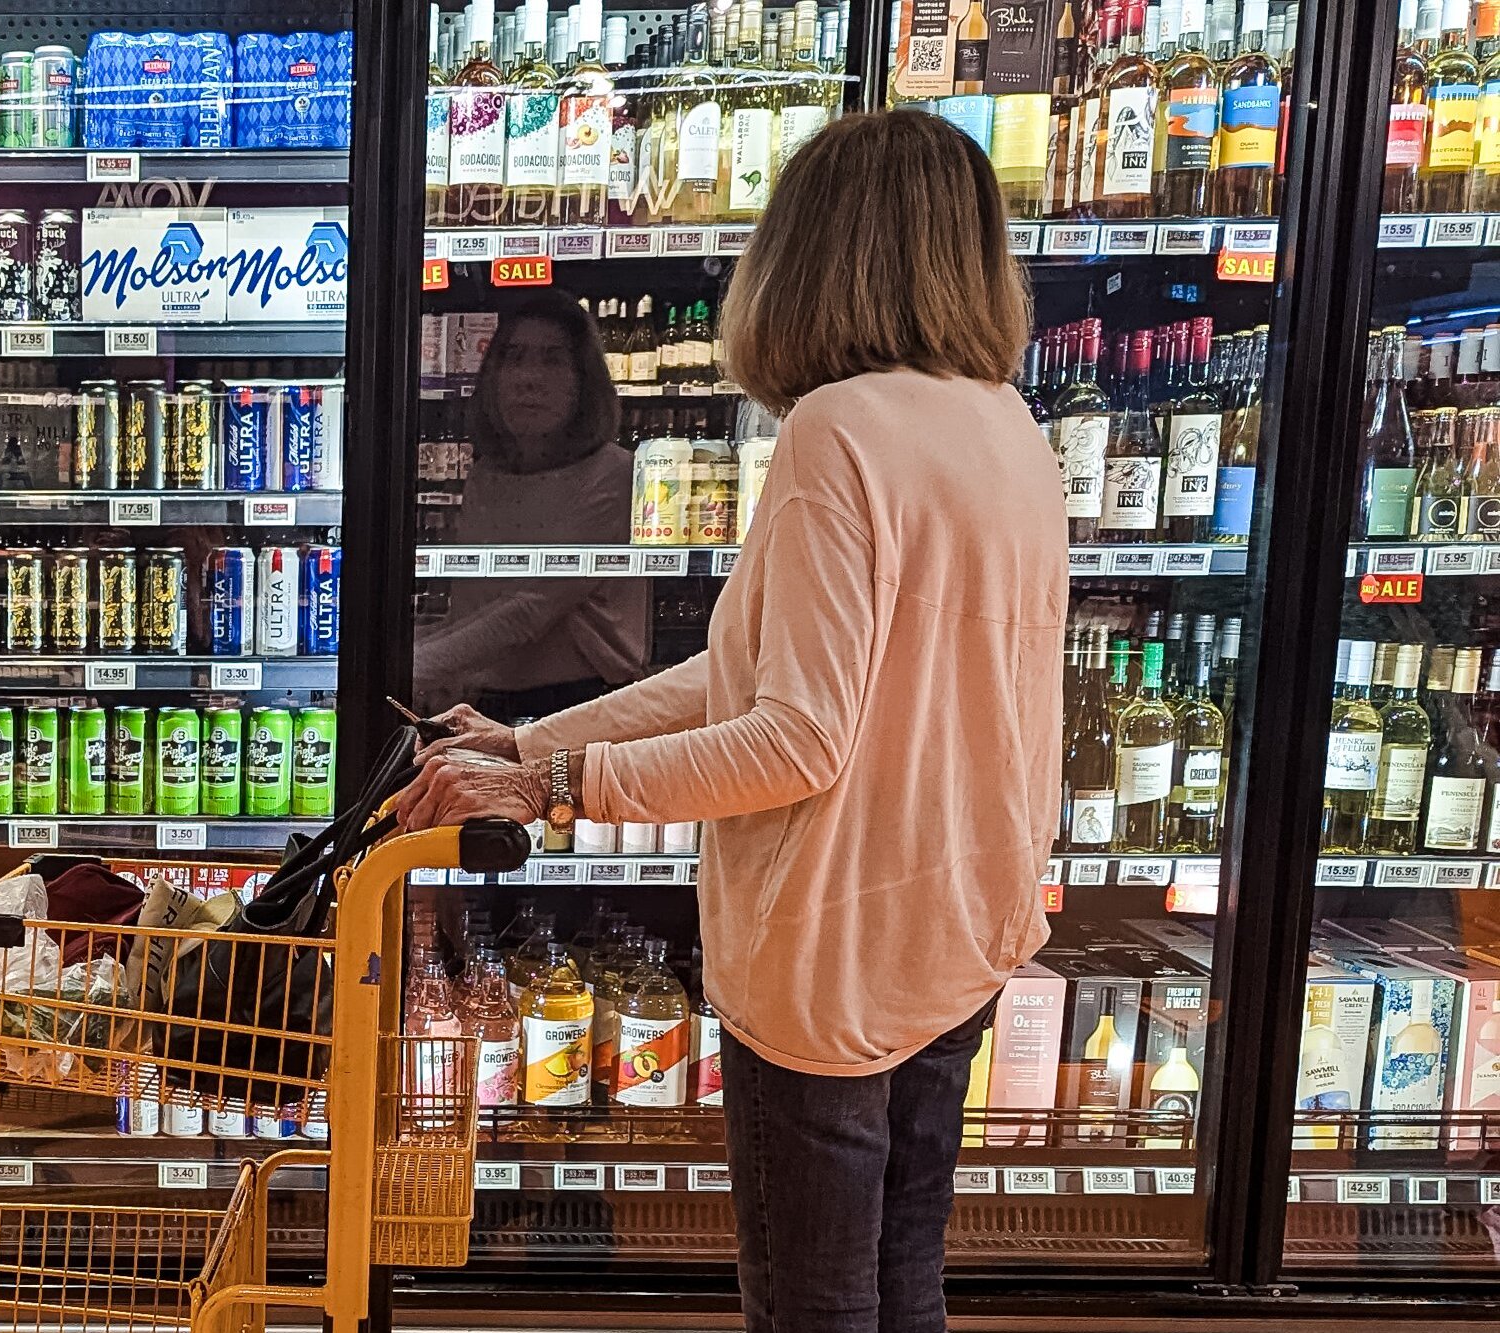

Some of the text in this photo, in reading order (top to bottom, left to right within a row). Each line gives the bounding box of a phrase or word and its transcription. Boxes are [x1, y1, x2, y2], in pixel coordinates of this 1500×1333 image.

[1233, 100, 1271, 109] SANDBANKS
[460, 154, 501, 166] BODACIOUS
[513, 155, 555, 168] BODACIOUS
[559, 153, 601, 167] BODACIOUS
[1125, 158, 1147, 167] INK
[41, 228, 66, 239] Buck
[1384, 224, 1412, 234] 15.95
[1443, 223, 1472, 233] 15.95
[619, 235, 647, 245] 12.95
[671, 233, 700, 243] 11.95
[1235, 230, 1255, 240] 12.95
[457, 238, 485, 249] 12.95
[561, 237, 590, 247] 12.95
[499, 263, 546, 280] SALE
[1225, 257, 1274, 276] SALE
[82, 246, 230, 310] Molson
[162, 292, 200, 303] ULTRA
[306, 292, 346, 303] ULTRA
[13, 334, 43, 345] 12.95
[116, 334, 146, 345] 18.50
[240, 412, 253, 474] ULTRA
[300, 412, 310, 474] ULTRA
[314, 412, 323, 474] ULTRA
[1183, 481, 1207, 491] INK
[1119, 496, 1142, 506] INK
[121, 504, 150, 514] 17.95
[254, 504, 273, 513] 16.95
[652, 555, 675, 565] 3.75
[1444, 553, 1467, 563] 5.95
[1373, 580, 1417, 597] SALE
[214, 579, 225, 638] ULTRA
[271, 580, 283, 638] ULTRA
[319, 579, 333, 639] ULTRA
[97, 669, 125, 681] 14.95
[226, 668, 248, 679] 3.30
[1335, 737, 1364, 745] HENRY
[20, 828, 47, 838] 17.95
[171, 829, 193, 839] 3.50
[548, 865, 570, 875] 3.95
[598, 865, 620, 874] 3.95
[1080, 865, 1100, 873] 16.95
[1132, 866, 1160, 875] 15.95
[1327, 866, 1356, 875] 15.95
[1390, 867, 1418, 876] 16.95
[1442, 867, 1470, 877] 16.95
[1012, 995, 1044, 1006] BASK
[1173, 997, 1201, 1009] WEEKS
[545, 1028, 586, 1041] GROWERS
[621, 1026, 664, 1040] GROWERS
[1305, 1066, 1340, 1076] SAWMILL
[172, 1168, 194, 1179] 3.40
[485, 1169, 507, 1179] 9.95
[1015, 1173, 1045, 1185] 42.95
[1095, 1173, 1125, 1185] 59.95
[1167, 1173, 1196, 1185] 40.95
[1350, 1182, 1380, 1194] 42.95
